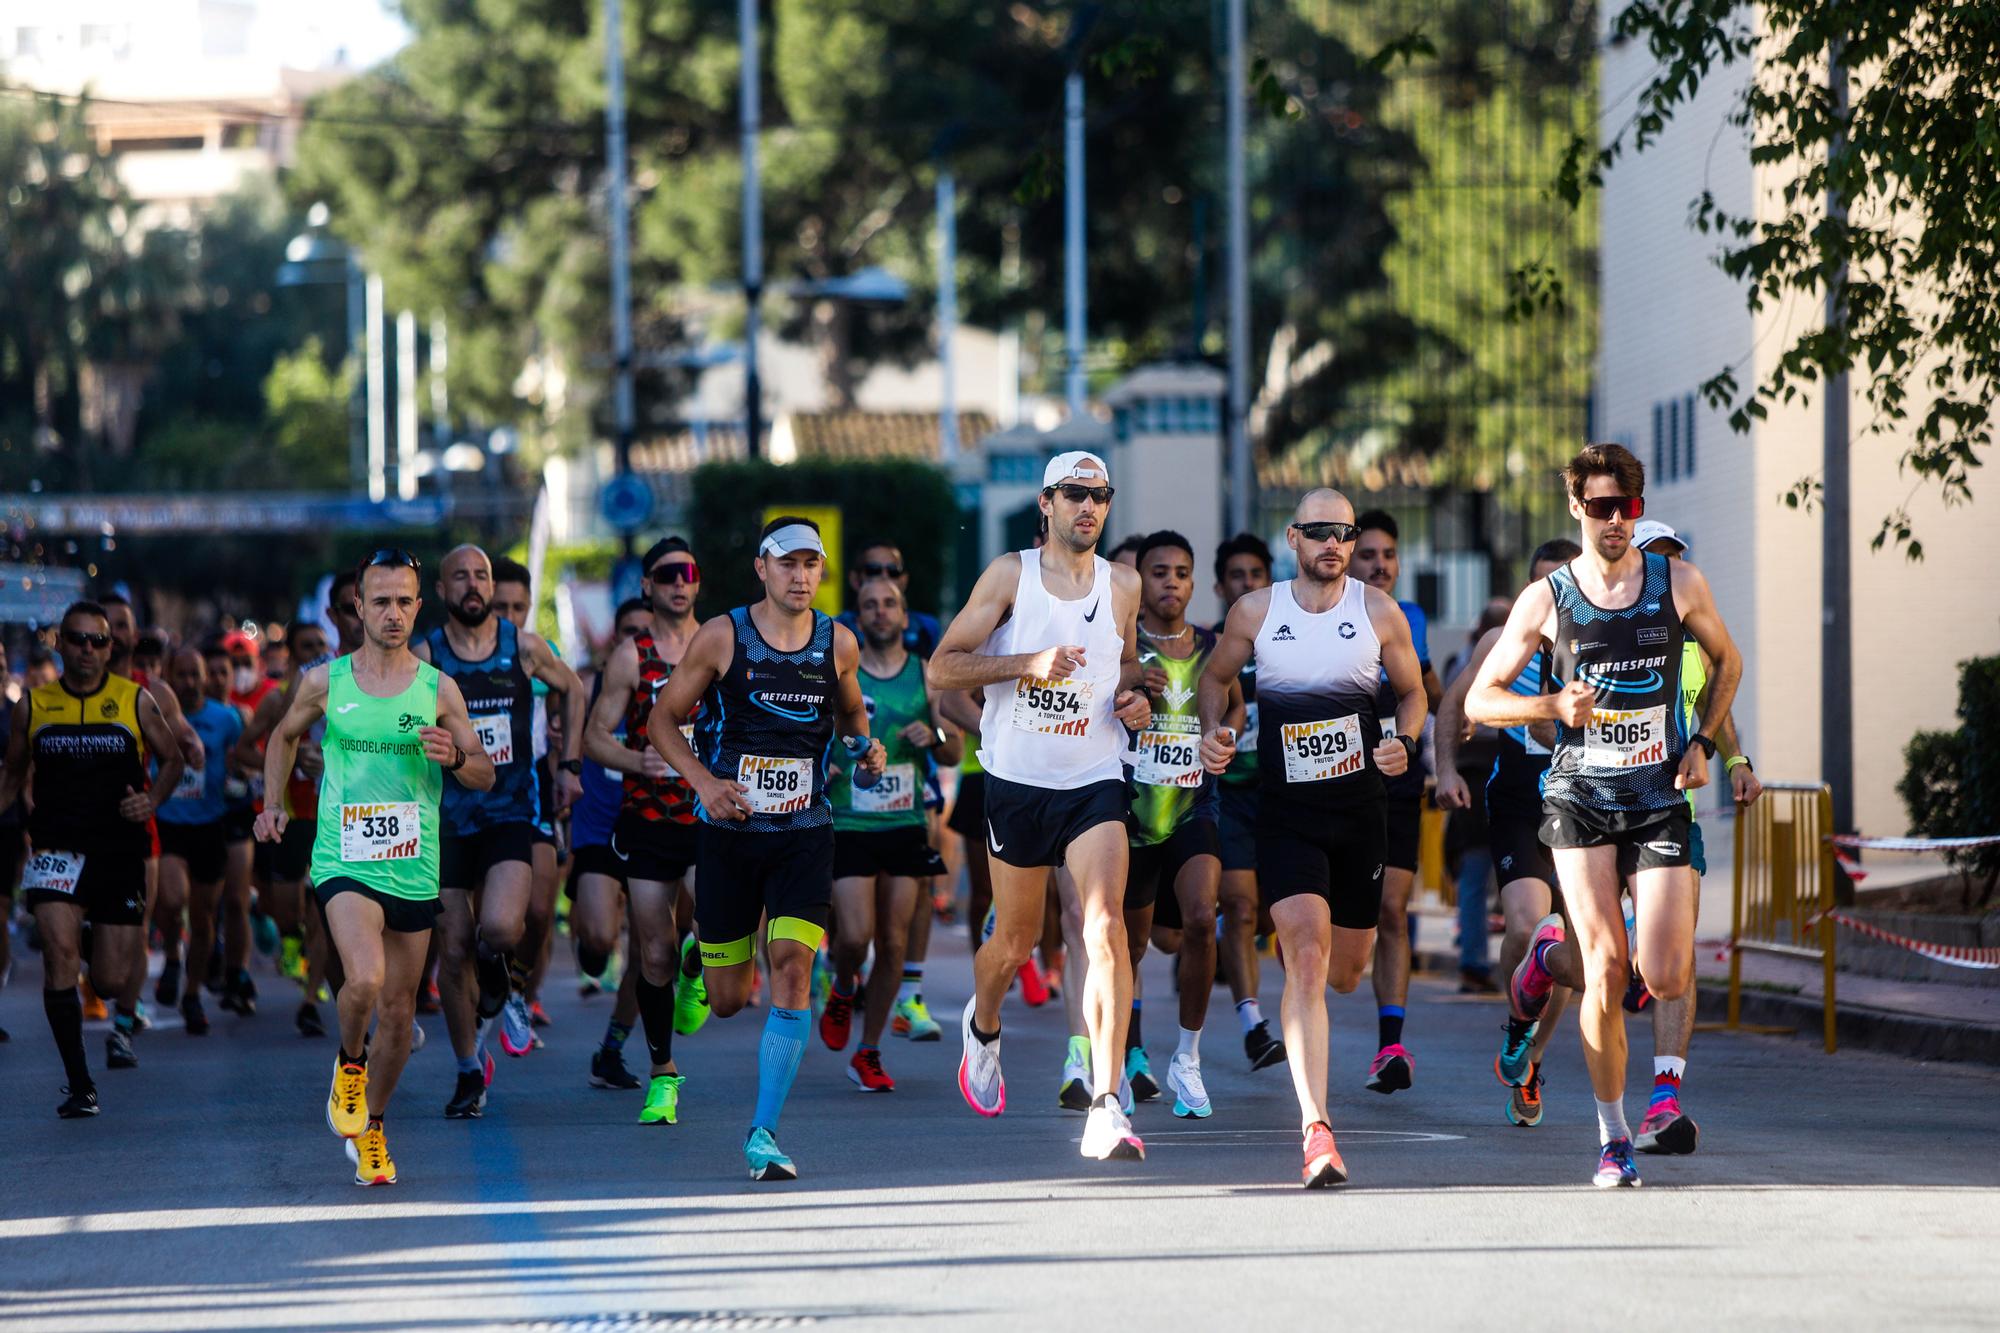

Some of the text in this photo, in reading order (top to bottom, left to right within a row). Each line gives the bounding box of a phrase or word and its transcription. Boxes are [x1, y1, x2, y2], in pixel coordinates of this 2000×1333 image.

[1589, 656, 1667, 674] METAESPORT
[760, 692, 825, 704] METAESPORT
[1028, 686, 1080, 714] 5934
[1601, 721, 1652, 745] 5065
[1153, 744, 1193, 767] 1626
[1297, 731, 1348, 759] 5929
[756, 769, 799, 792] 1588
[766, 791, 786, 799] SAMUEL
[362, 815, 400, 838] 338
